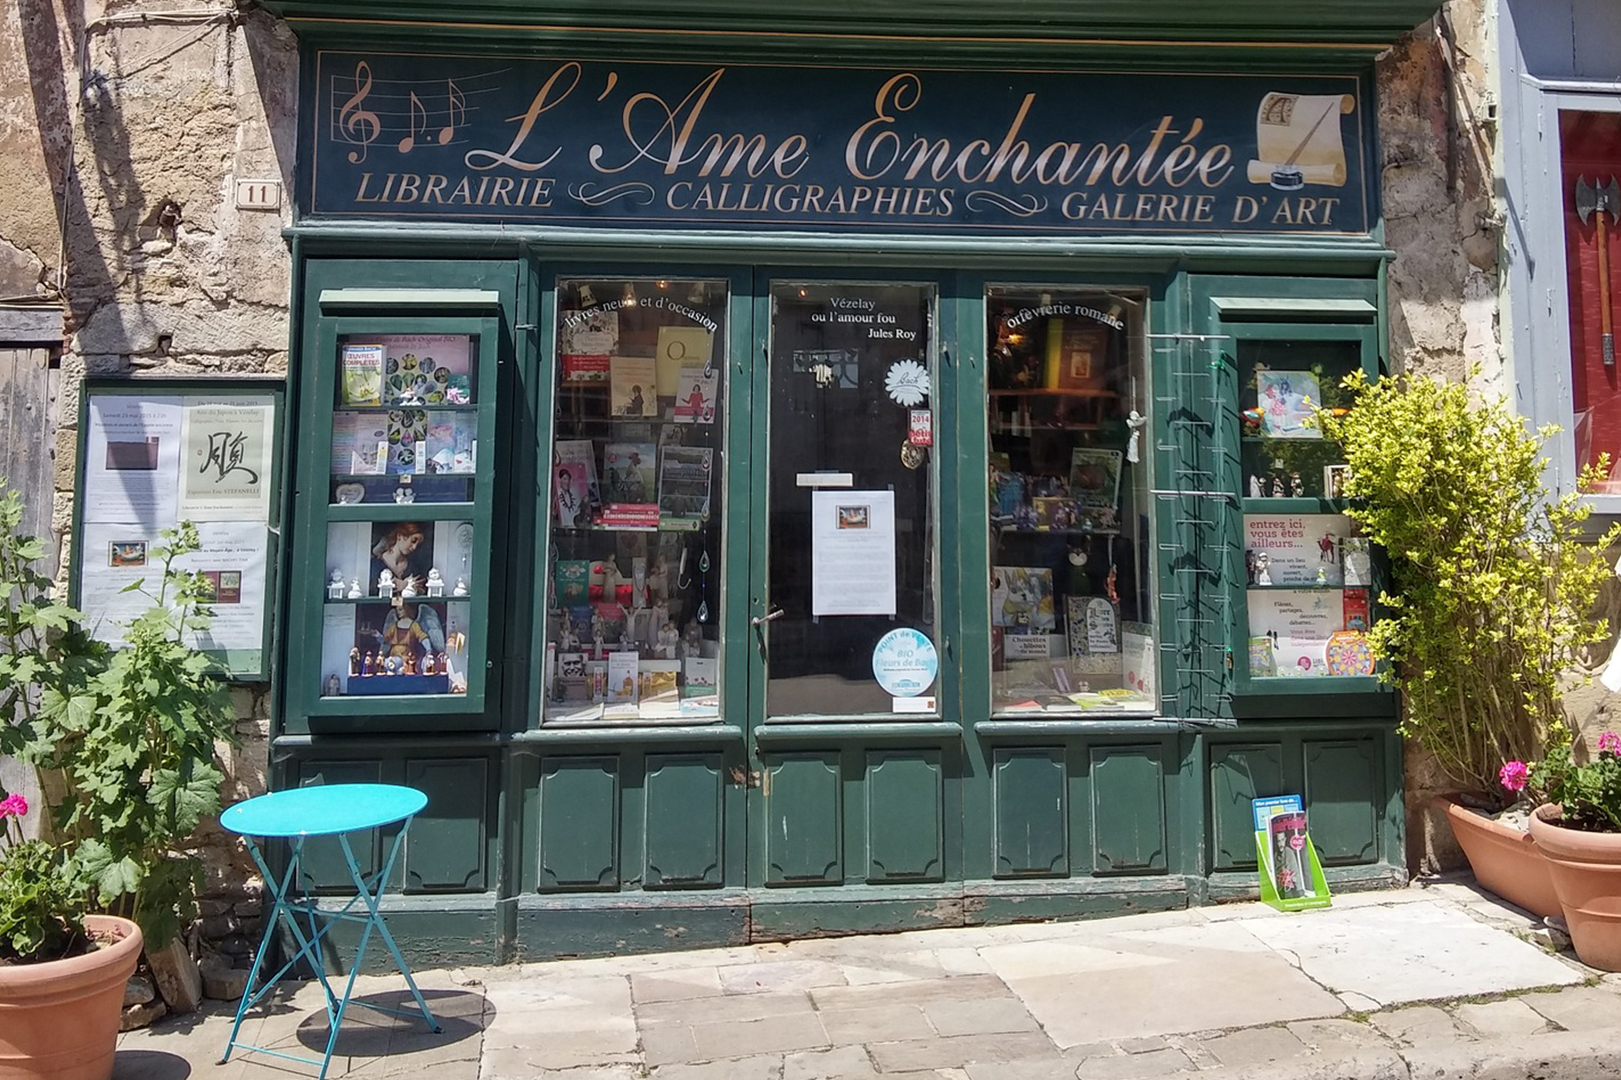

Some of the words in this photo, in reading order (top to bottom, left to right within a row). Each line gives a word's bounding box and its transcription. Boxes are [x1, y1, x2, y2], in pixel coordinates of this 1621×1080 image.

[465, 61, 810, 178] L'Ame
[845, 73, 1235, 187] Enchantée
[248, 185, 267, 203] 11
[355, 172, 556, 208] LIBRAIRIE
[666, 181, 955, 217] CALLIGRAPHIES
[1061, 191, 1216, 223] GALERIE
[830, 297, 876, 311] Vézelay
[564, 303, 600, 330] livres
[602, 298, 636, 312] neu
[640, 297, 652, 308] et
[655, 298, 719, 333] d'occasion
[811, 313, 826, 322] ou
[829, 311, 873, 323] l'amour
[877, 312, 896, 324] fou
[1006, 303, 1072, 329] orfèvrerie
[1074, 304, 1125, 331] romane
[868, 328, 893, 339] Jules
[895, 328, 917, 341] Roy
[912, 415, 929, 423] 2014
[1249, 520, 1286, 529] entrez
[1290, 518, 1306, 530] ici,
[1251, 530, 1278, 538] vous
[1281, 528, 1304, 538] êtes
[1251, 538, 1303, 548] ailleurs...
[878, 632, 898, 654] POINT
[897, 650, 914, 658] BIO
[902, 659, 913, 667] de
